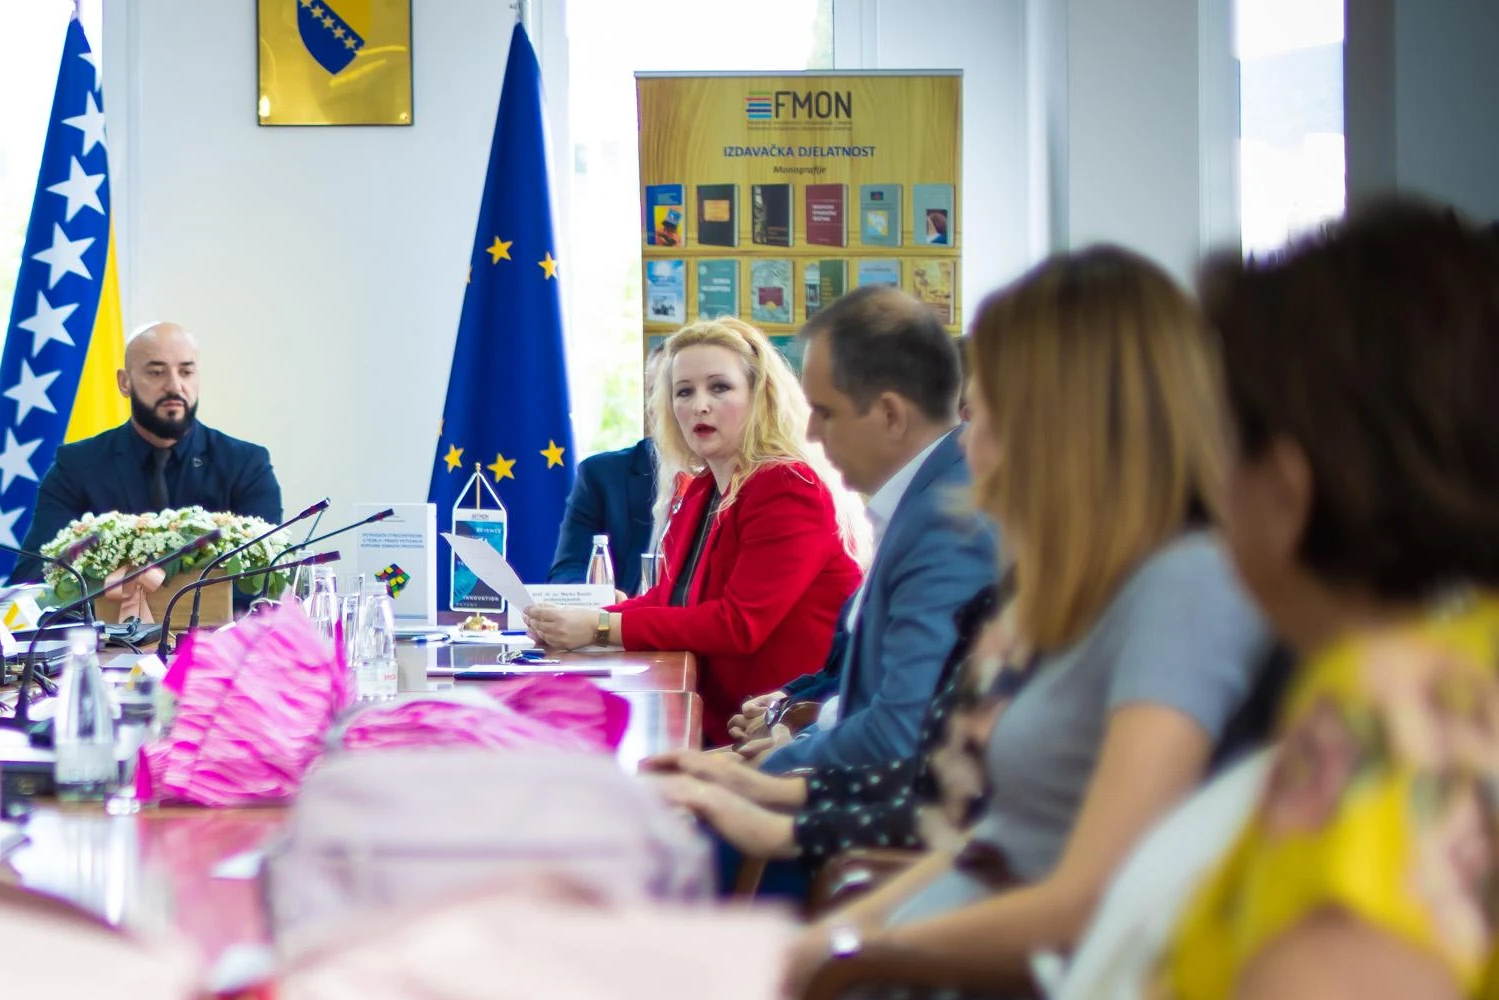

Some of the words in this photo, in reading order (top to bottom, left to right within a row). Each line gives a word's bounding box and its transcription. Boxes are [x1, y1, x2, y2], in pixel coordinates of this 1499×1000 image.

[774, 91, 853, 119] FMON
[723, 144, 794, 158] IZDAVAČKA
[798, 146, 877, 159] DJELATNOST
[772, 164, 828, 176] Monografije
